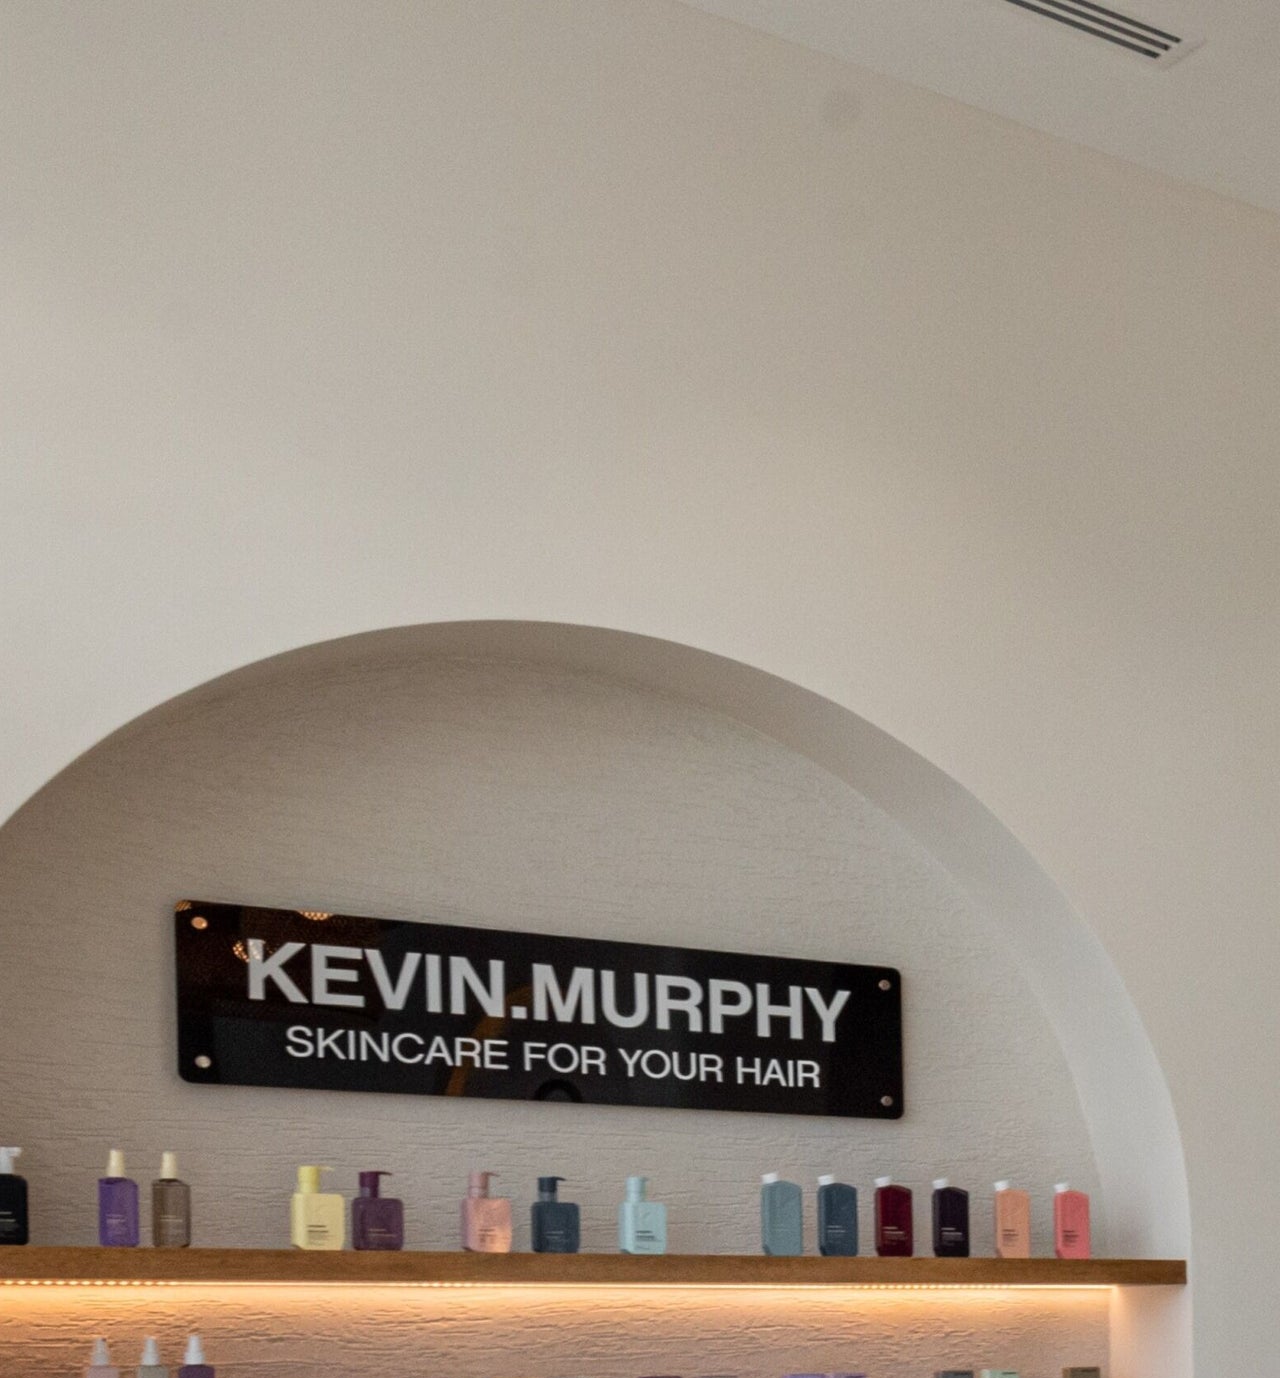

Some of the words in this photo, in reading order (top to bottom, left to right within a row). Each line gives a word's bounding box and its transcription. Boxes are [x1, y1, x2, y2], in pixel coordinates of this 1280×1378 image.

[246, 938, 851, 1042] KEVIN.MURPHY
[286, 1026, 509, 1070] SKINCARE
[525, 1043, 606, 1076] FOR
[618, 1048, 723, 1083] YOUR
[736, 1056, 820, 1088] HAIR
